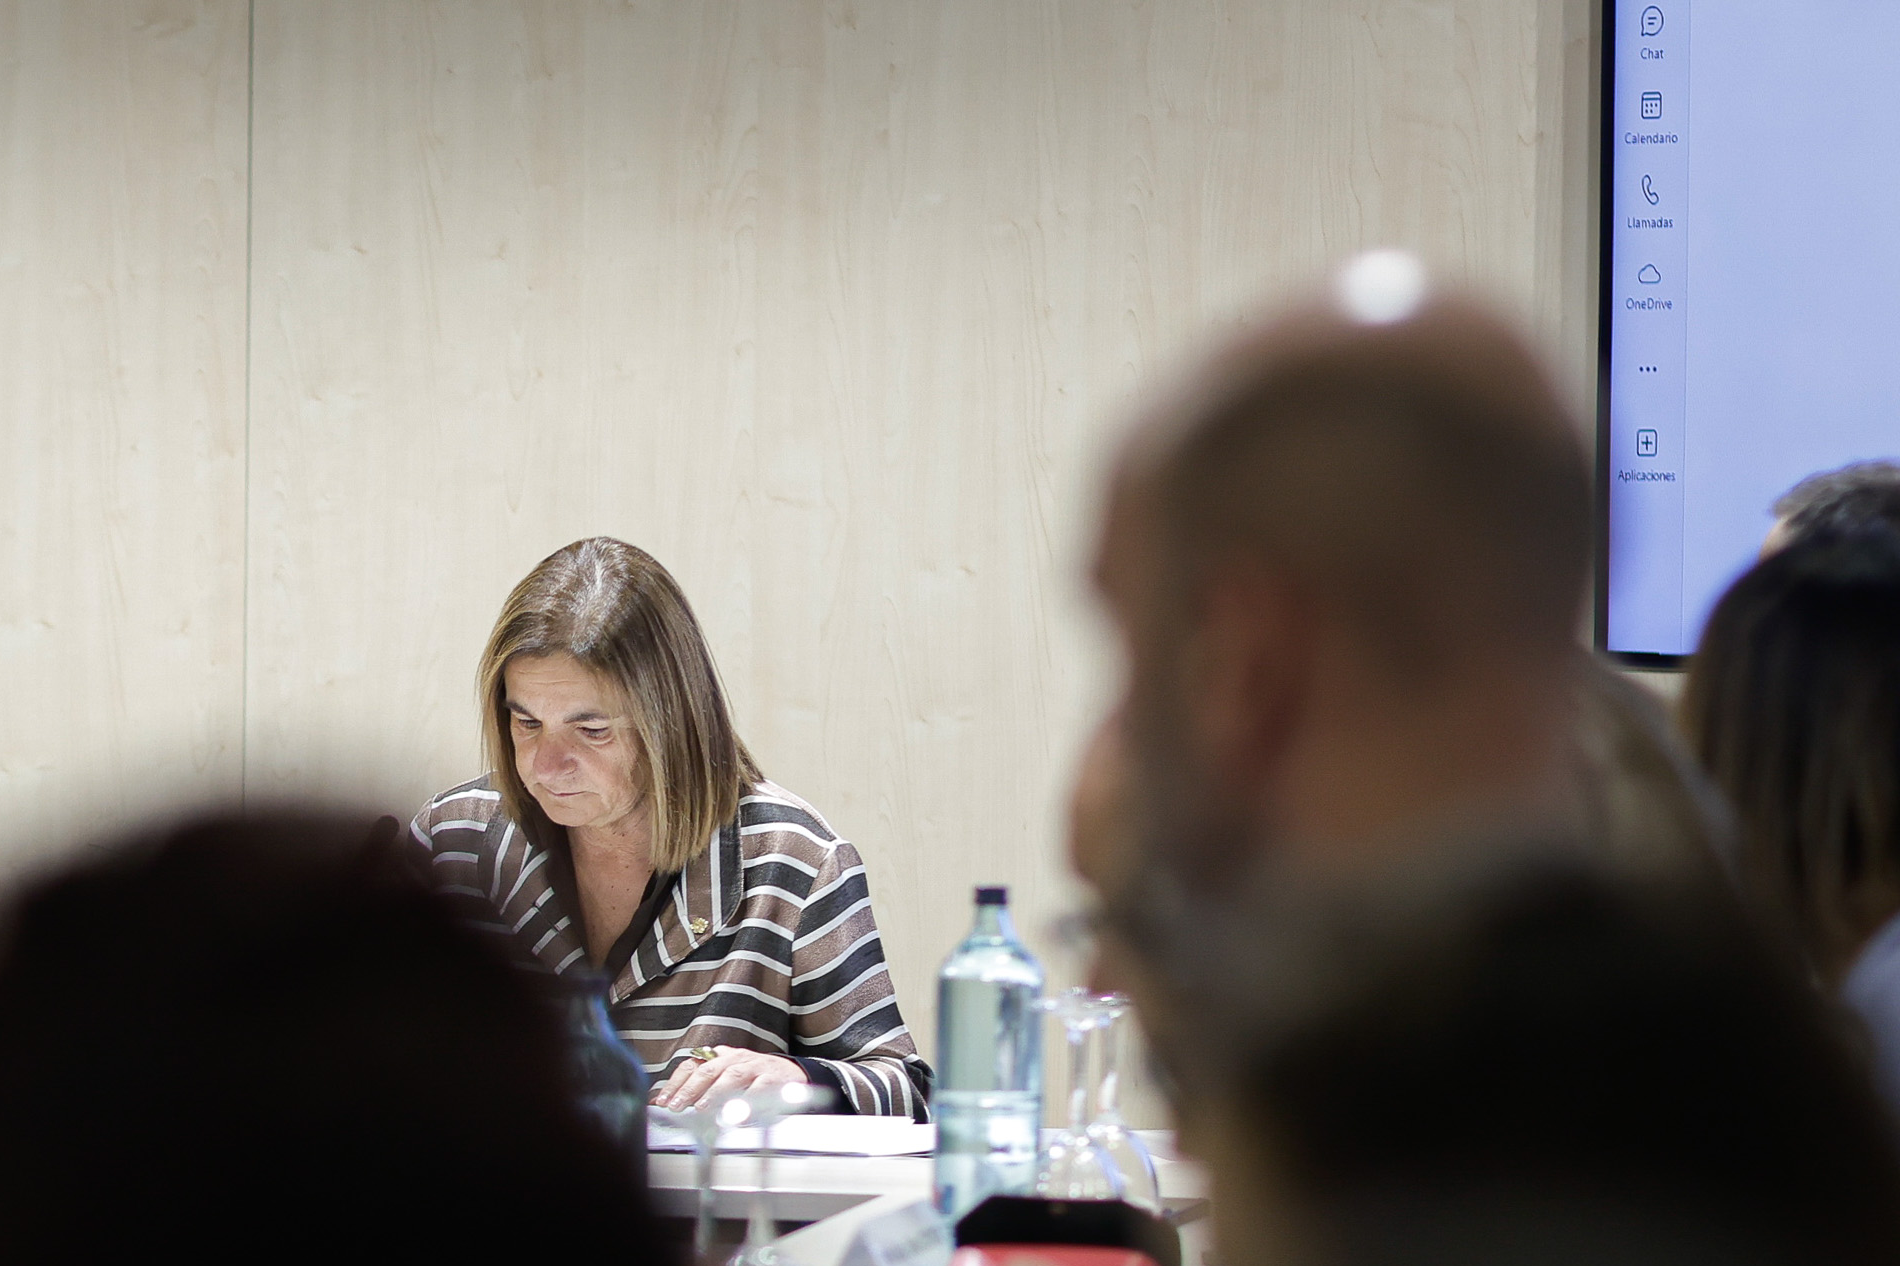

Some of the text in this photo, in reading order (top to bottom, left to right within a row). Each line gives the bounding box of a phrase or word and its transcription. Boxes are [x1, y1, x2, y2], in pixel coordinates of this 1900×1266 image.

[1640, 47, 1664, 60] Chat
[1624, 132, 1678, 145] Calendario
[1627, 216, 1674, 229] Llamadas
[1625, 298, 1673, 311] OneDrive
[1618, 469, 1676, 483] Aplicaciones
